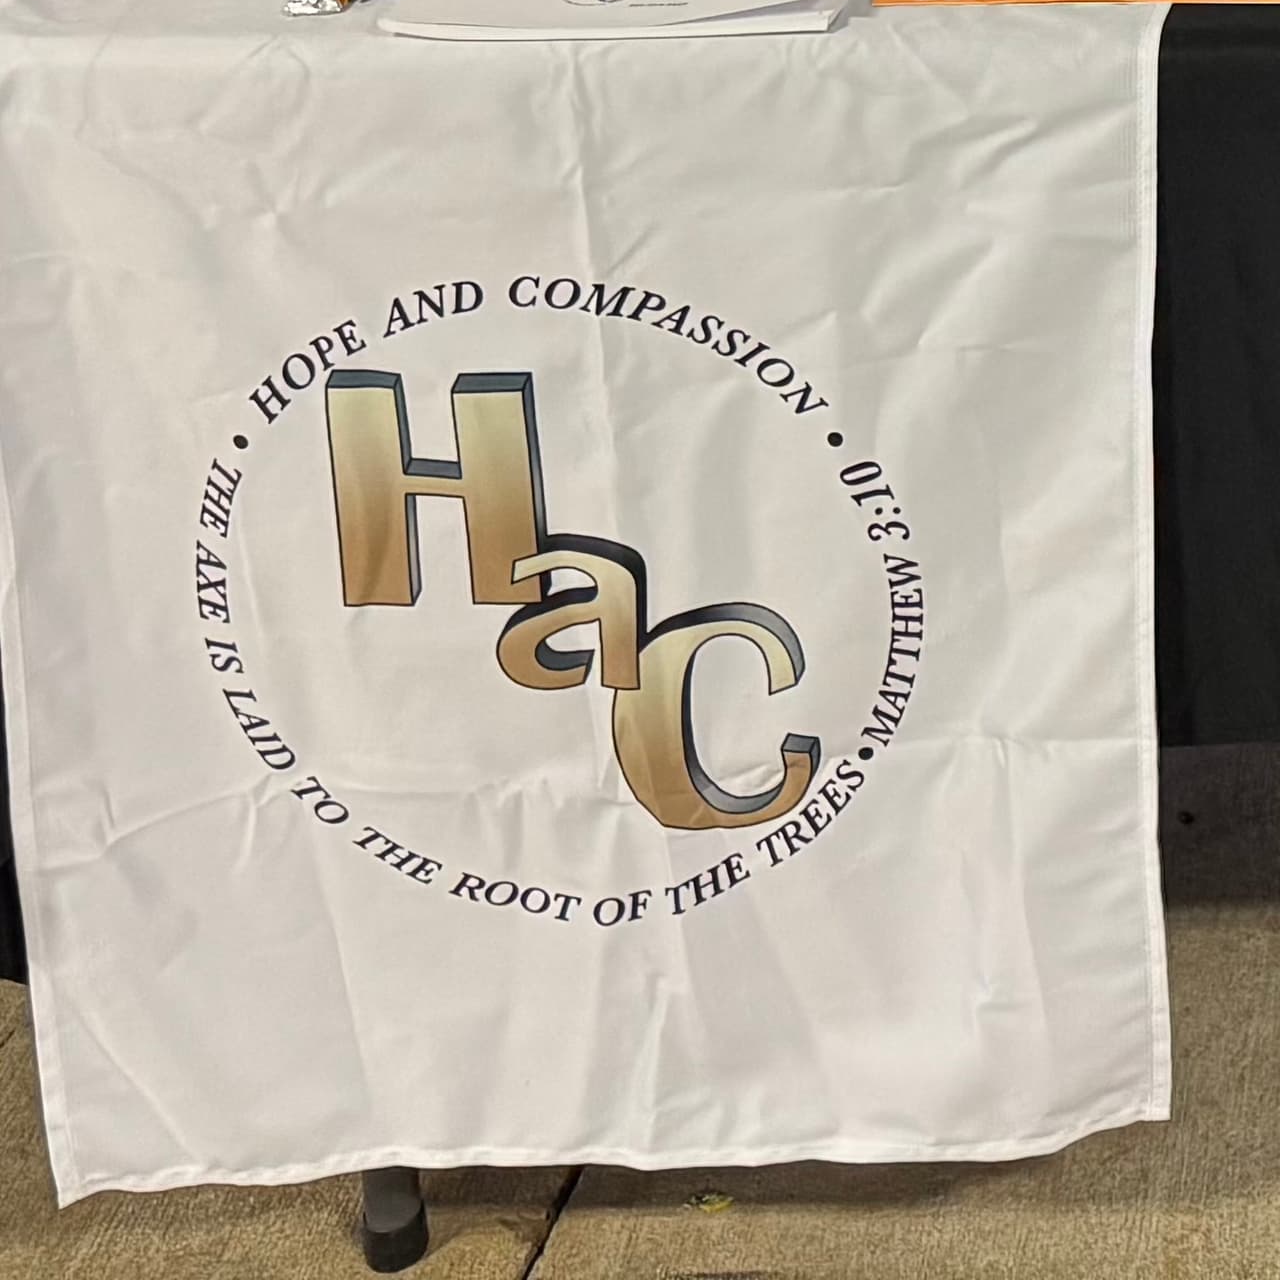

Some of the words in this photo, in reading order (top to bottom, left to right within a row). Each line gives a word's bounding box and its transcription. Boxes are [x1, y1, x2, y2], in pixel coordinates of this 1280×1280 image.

[246, 319, 368, 425] HOPE
[382, 278, 486, 340] AND
[507, 274, 831, 418] COMPASSION
[200, 456, 243, 538] THE
[837, 459, 913, 543] 3:10
[195, 540, 233, 624] AXE
[324, 368, 822, 830] HaC
[204, 637, 245, 677] IS
[866, 552, 926, 748] MATTHEW
[222, 686, 298, 773] LAID
[291, 774, 351, 828] TO
[755, 756, 870, 870] TREES
[351, 824, 444, 887] THE
[664, 851, 753, 919] THE
[449, 870, 583, 925] ROOT
[591, 889, 652, 929] OF
